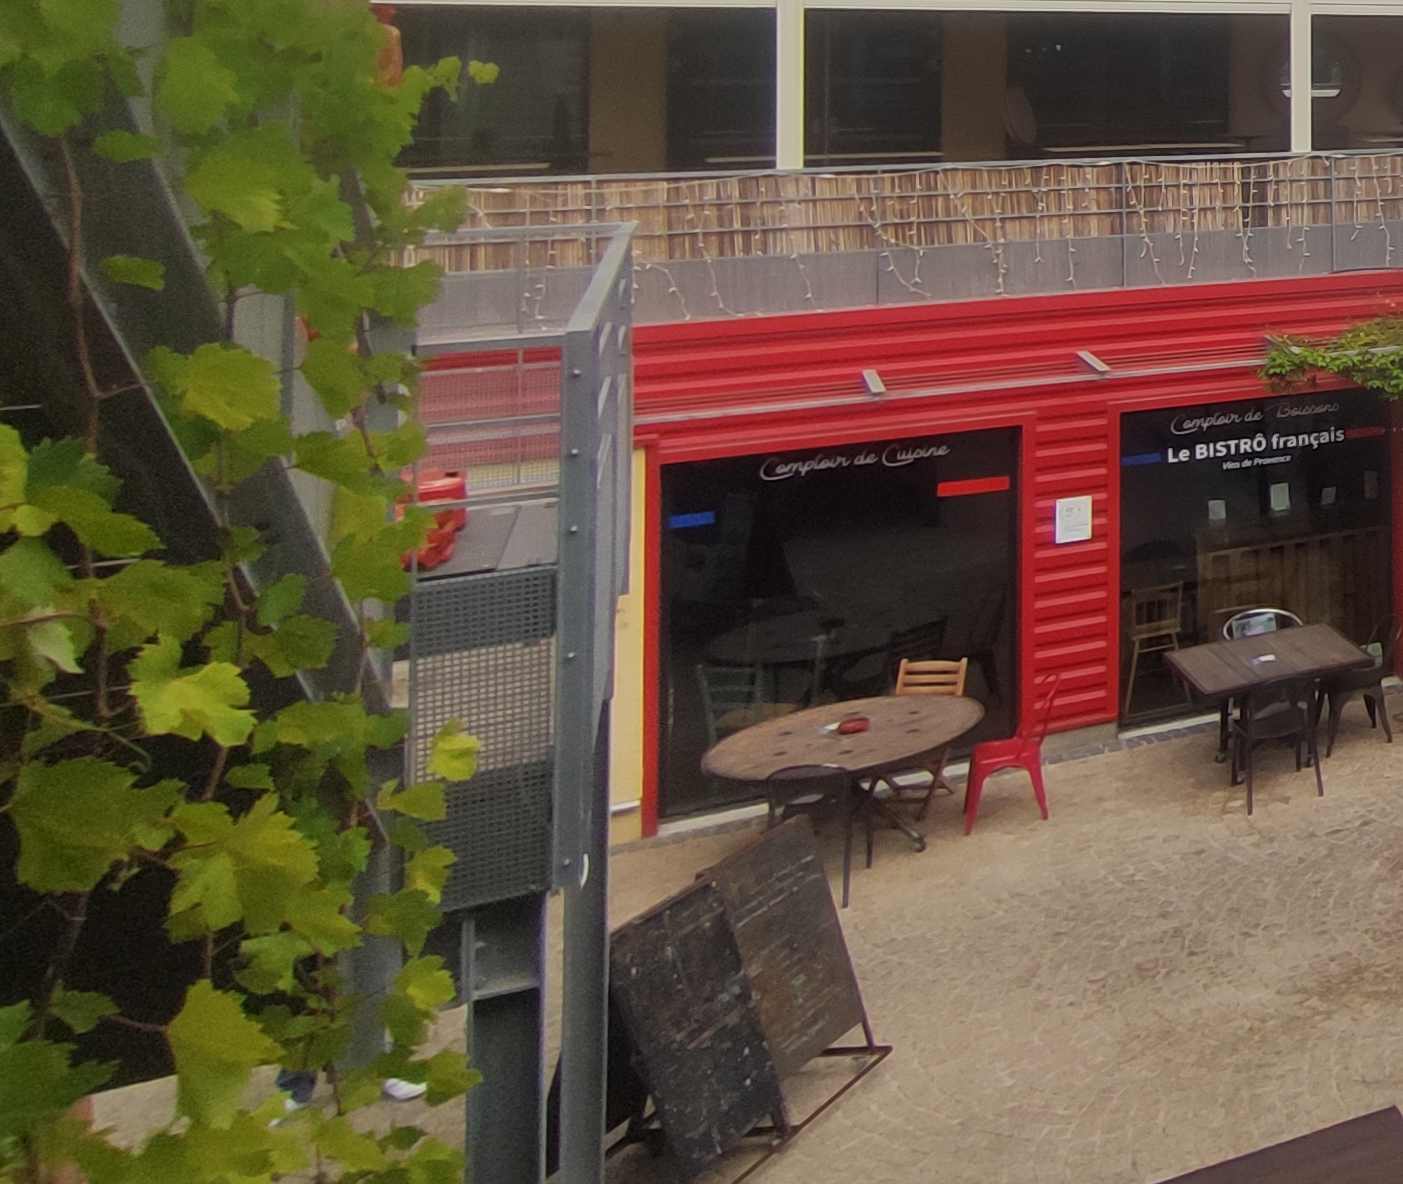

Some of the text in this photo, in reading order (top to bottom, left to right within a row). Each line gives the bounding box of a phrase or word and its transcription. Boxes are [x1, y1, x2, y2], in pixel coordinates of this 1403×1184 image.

[1170, 401, 1340, 435] Comptoir de Boissons
[759, 442, 950, 481] Comptoir de Cuisine
[1167, 425, 1345, 464] Le BISTRÔ français
